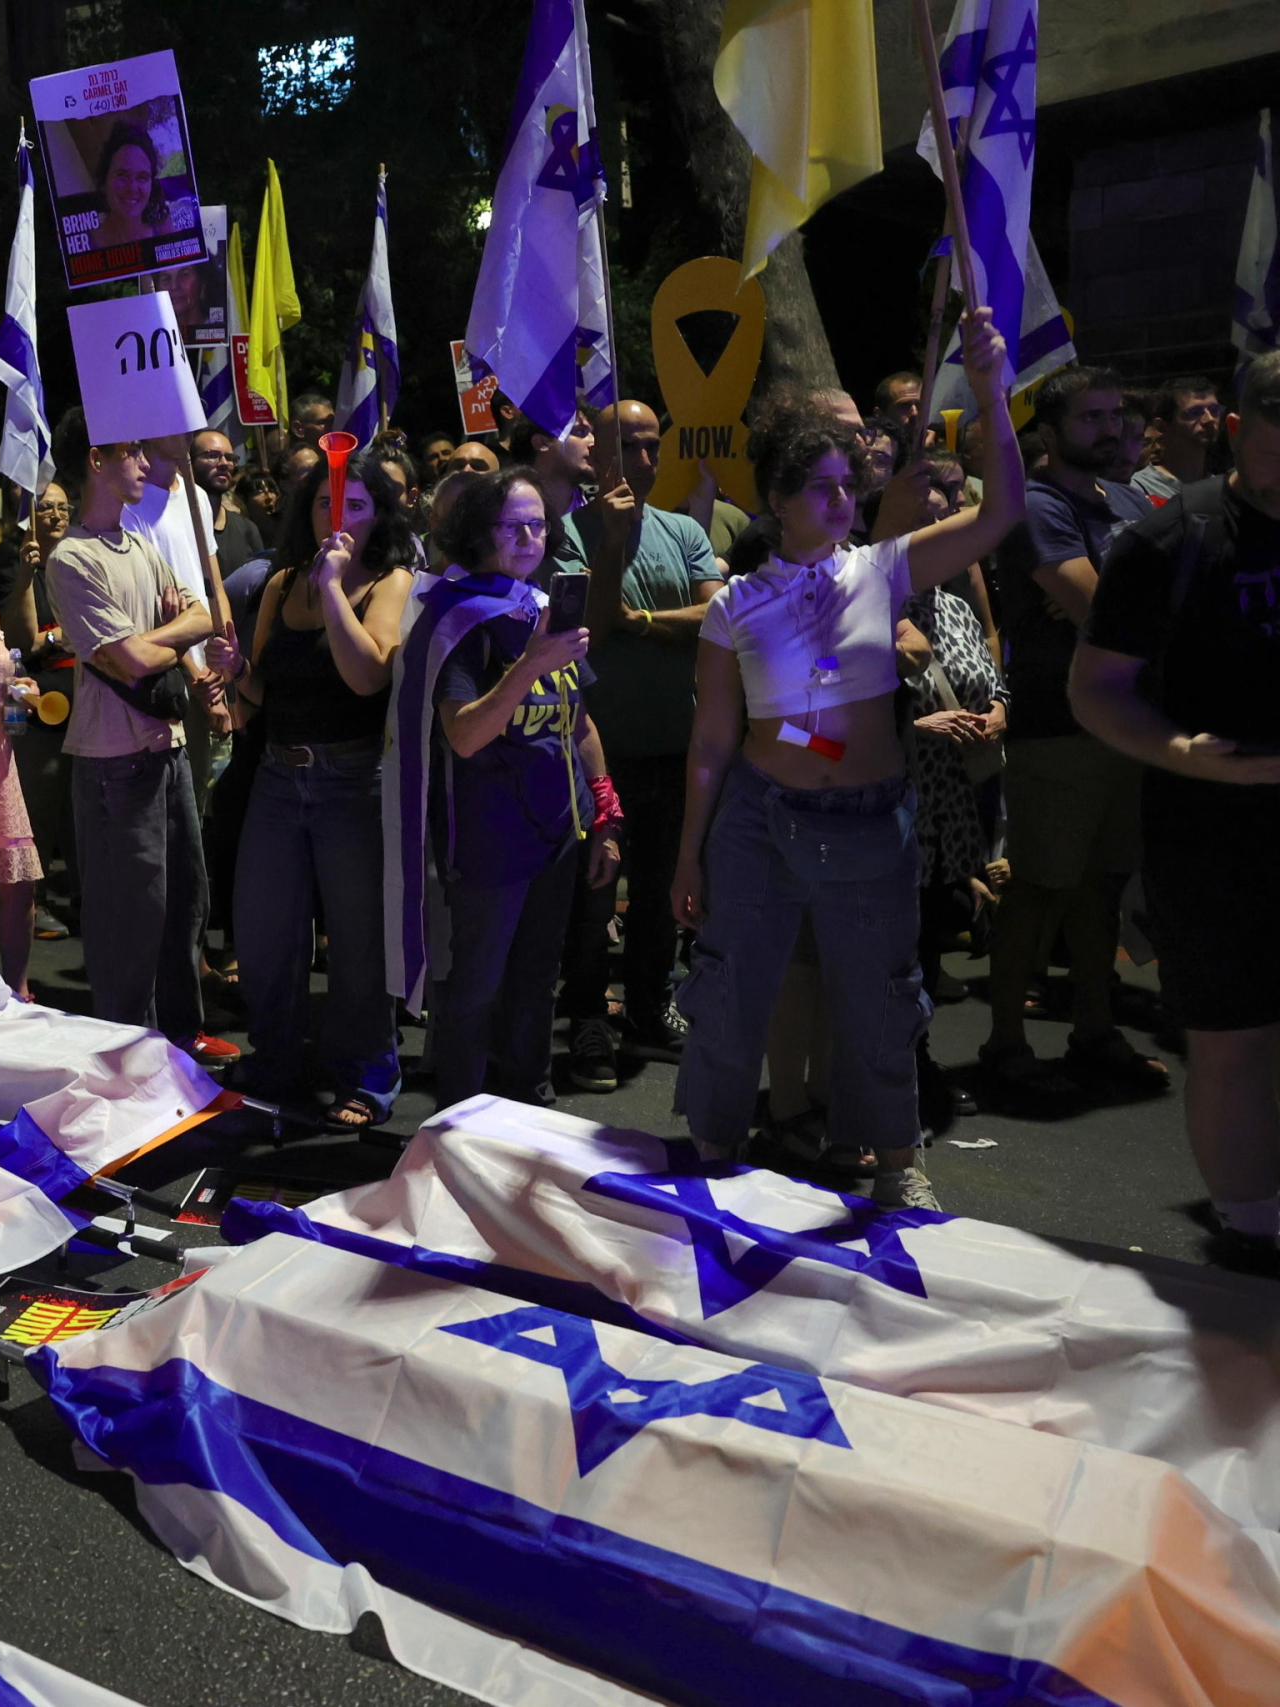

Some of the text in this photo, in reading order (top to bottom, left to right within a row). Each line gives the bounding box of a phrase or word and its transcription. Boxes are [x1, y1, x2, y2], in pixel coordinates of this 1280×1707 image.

[99, 69, 119, 83] כרמל
[83, 80, 128, 102] CARMEL GAT
[89, 99, 111, 114] (40)
[62, 210, 100, 235] BRING
[65, 233, 91, 255] HER
[679, 425, 737, 459] NOW.
[0, 1301, 76, 1345] אותנו
